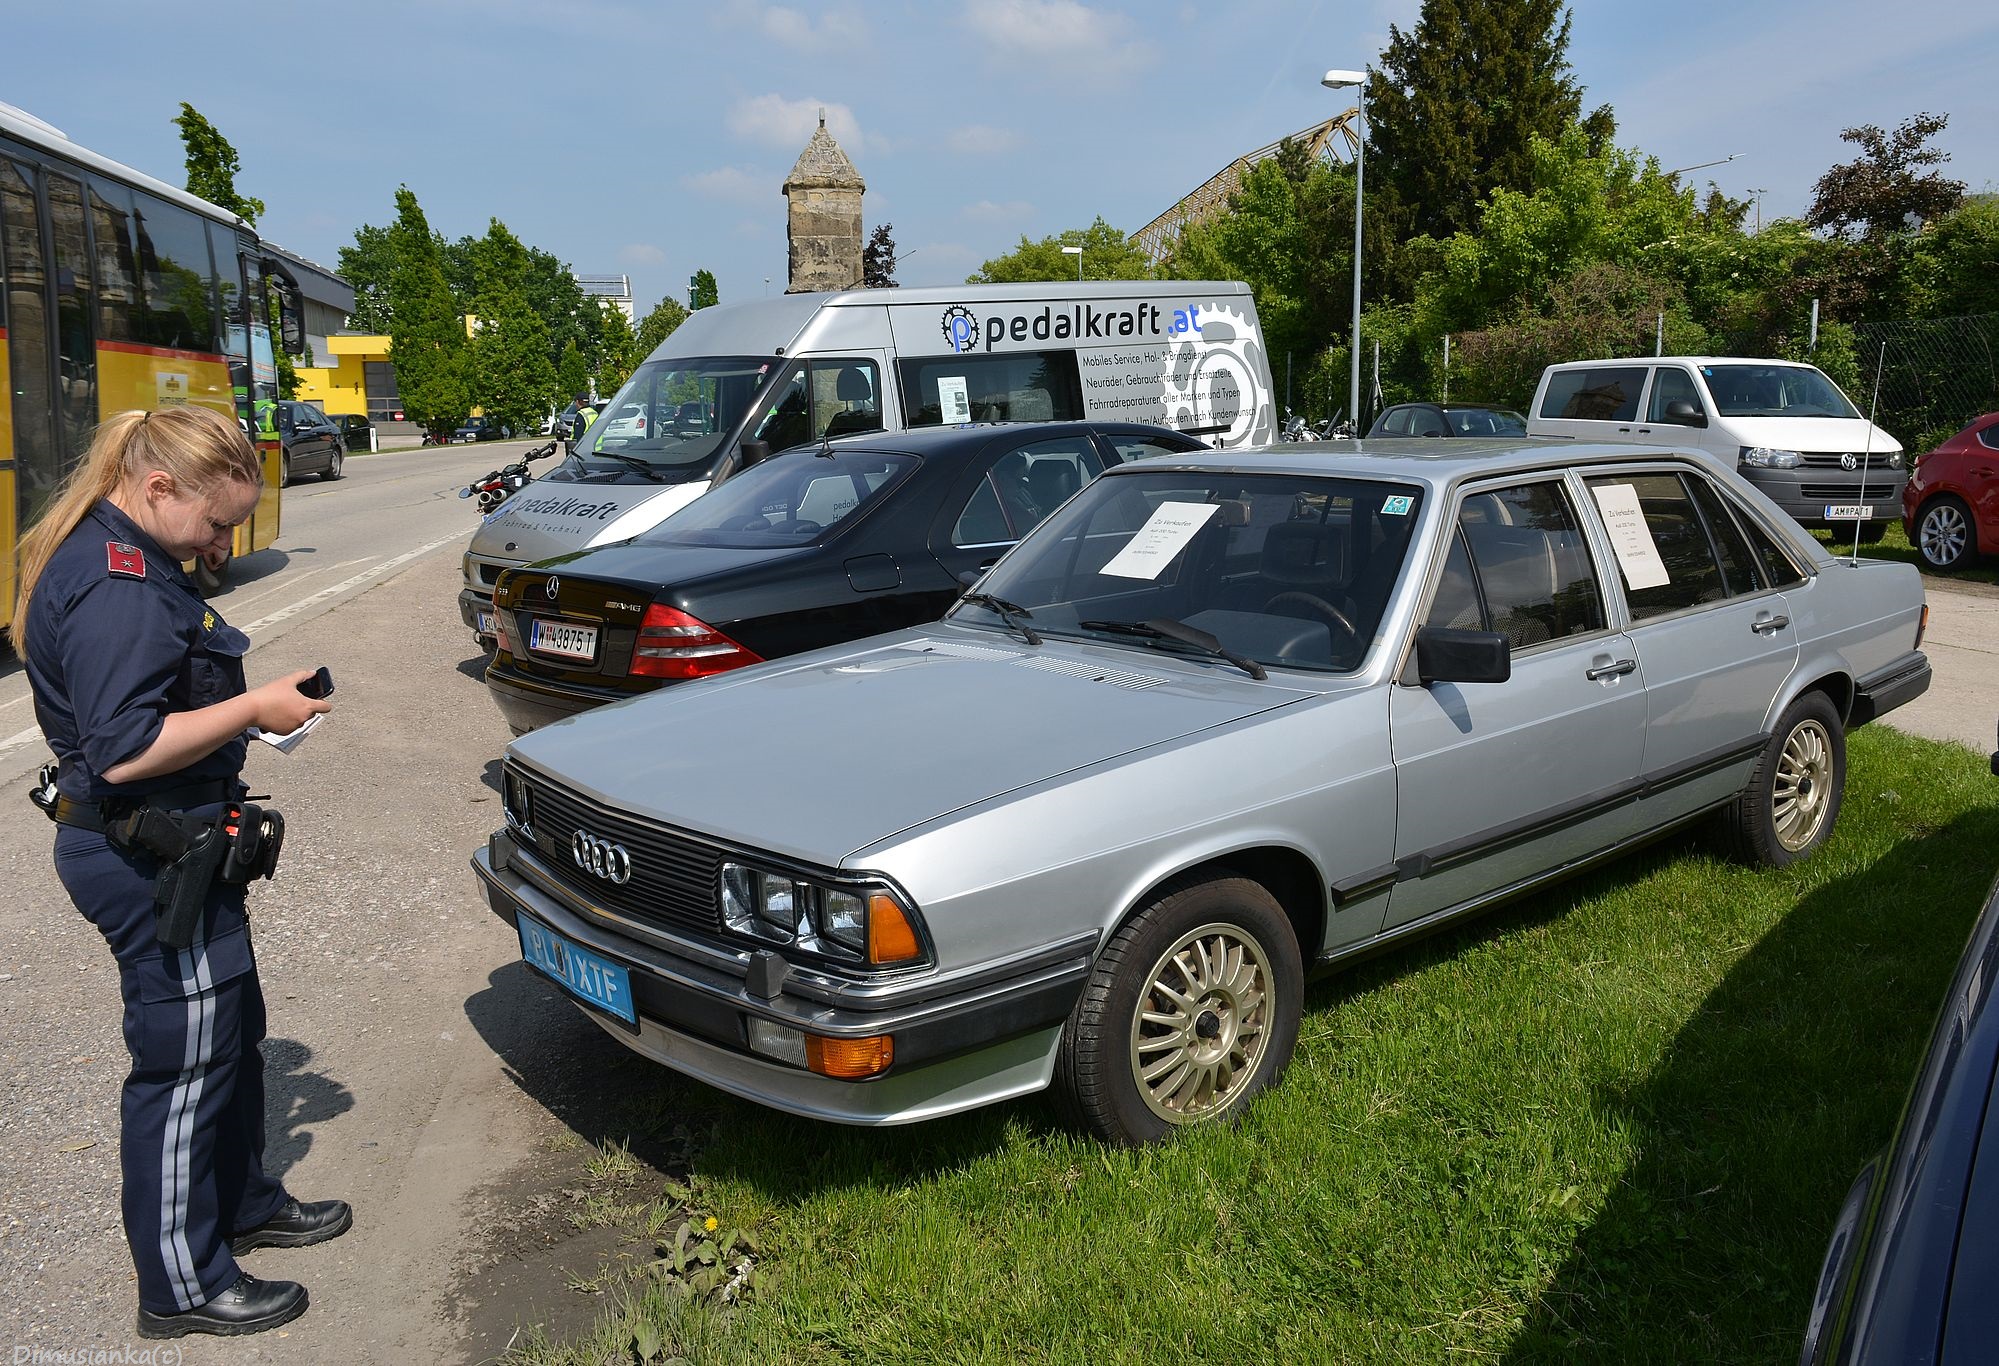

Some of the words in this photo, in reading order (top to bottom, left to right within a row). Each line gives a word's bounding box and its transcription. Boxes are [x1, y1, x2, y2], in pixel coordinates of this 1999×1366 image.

[1083, 354, 1112, 366] Mobiles
[1114, 353, 1143, 365] Service,
[1144, 351, 1160, 362] Hol-
[1169, 349, 1207, 363] Bringdienst
[1086, 375, 1125, 388] Neuräder,
[1126, 371, 1182, 386] Gebrauchträder
[1184, 370, 1197, 381] und
[1199, 368, 1232, 380] Ersatzteile
[1089, 396, 1161, 410] Fahrradreparaturen
[1163, 392, 1179, 403] aller
[1181, 391, 1206, 402] Marken
[1208, 388, 1220, 399] und
[1221, 387, 1240, 400] Typen
[1191, 410, 1204, 421] nach
[1208, 407, 1256, 419] Kundenwunsch
[515, 497, 618, 520] pedalkraft
[1834, 507, 1846, 516] AM
[542, 523, 582, 535] Technik
[615, 602, 641, 613] AMG
[538, 625, 546, 646] W
[531, 930, 556, 971] PL
